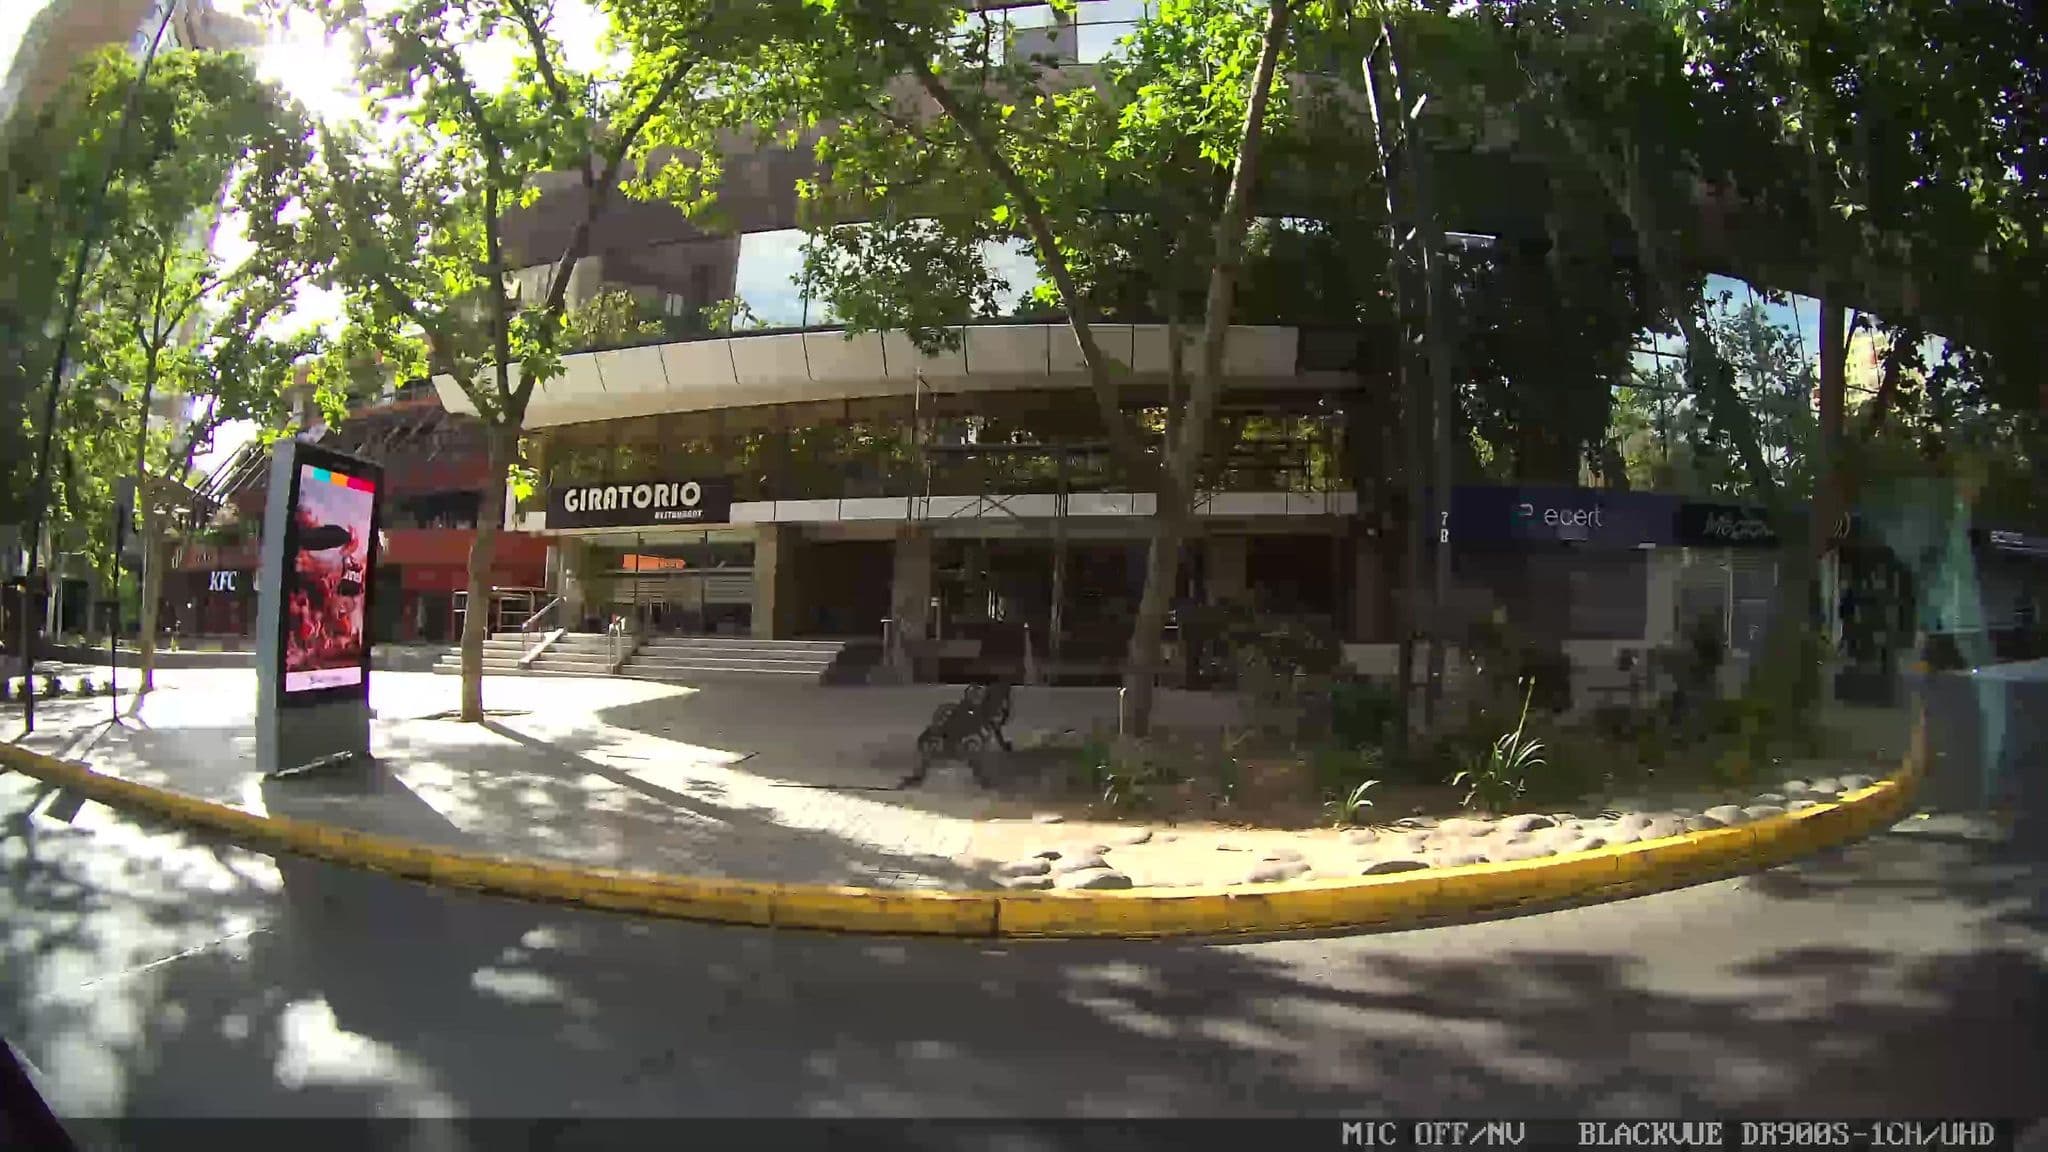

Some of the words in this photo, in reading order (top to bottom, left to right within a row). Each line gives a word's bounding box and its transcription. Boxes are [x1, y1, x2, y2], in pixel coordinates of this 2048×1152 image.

[564, 481, 701, 513] GIRATORIO
[1544, 503, 1603, 527] ecert
[208, 570, 237, 591] KFC
